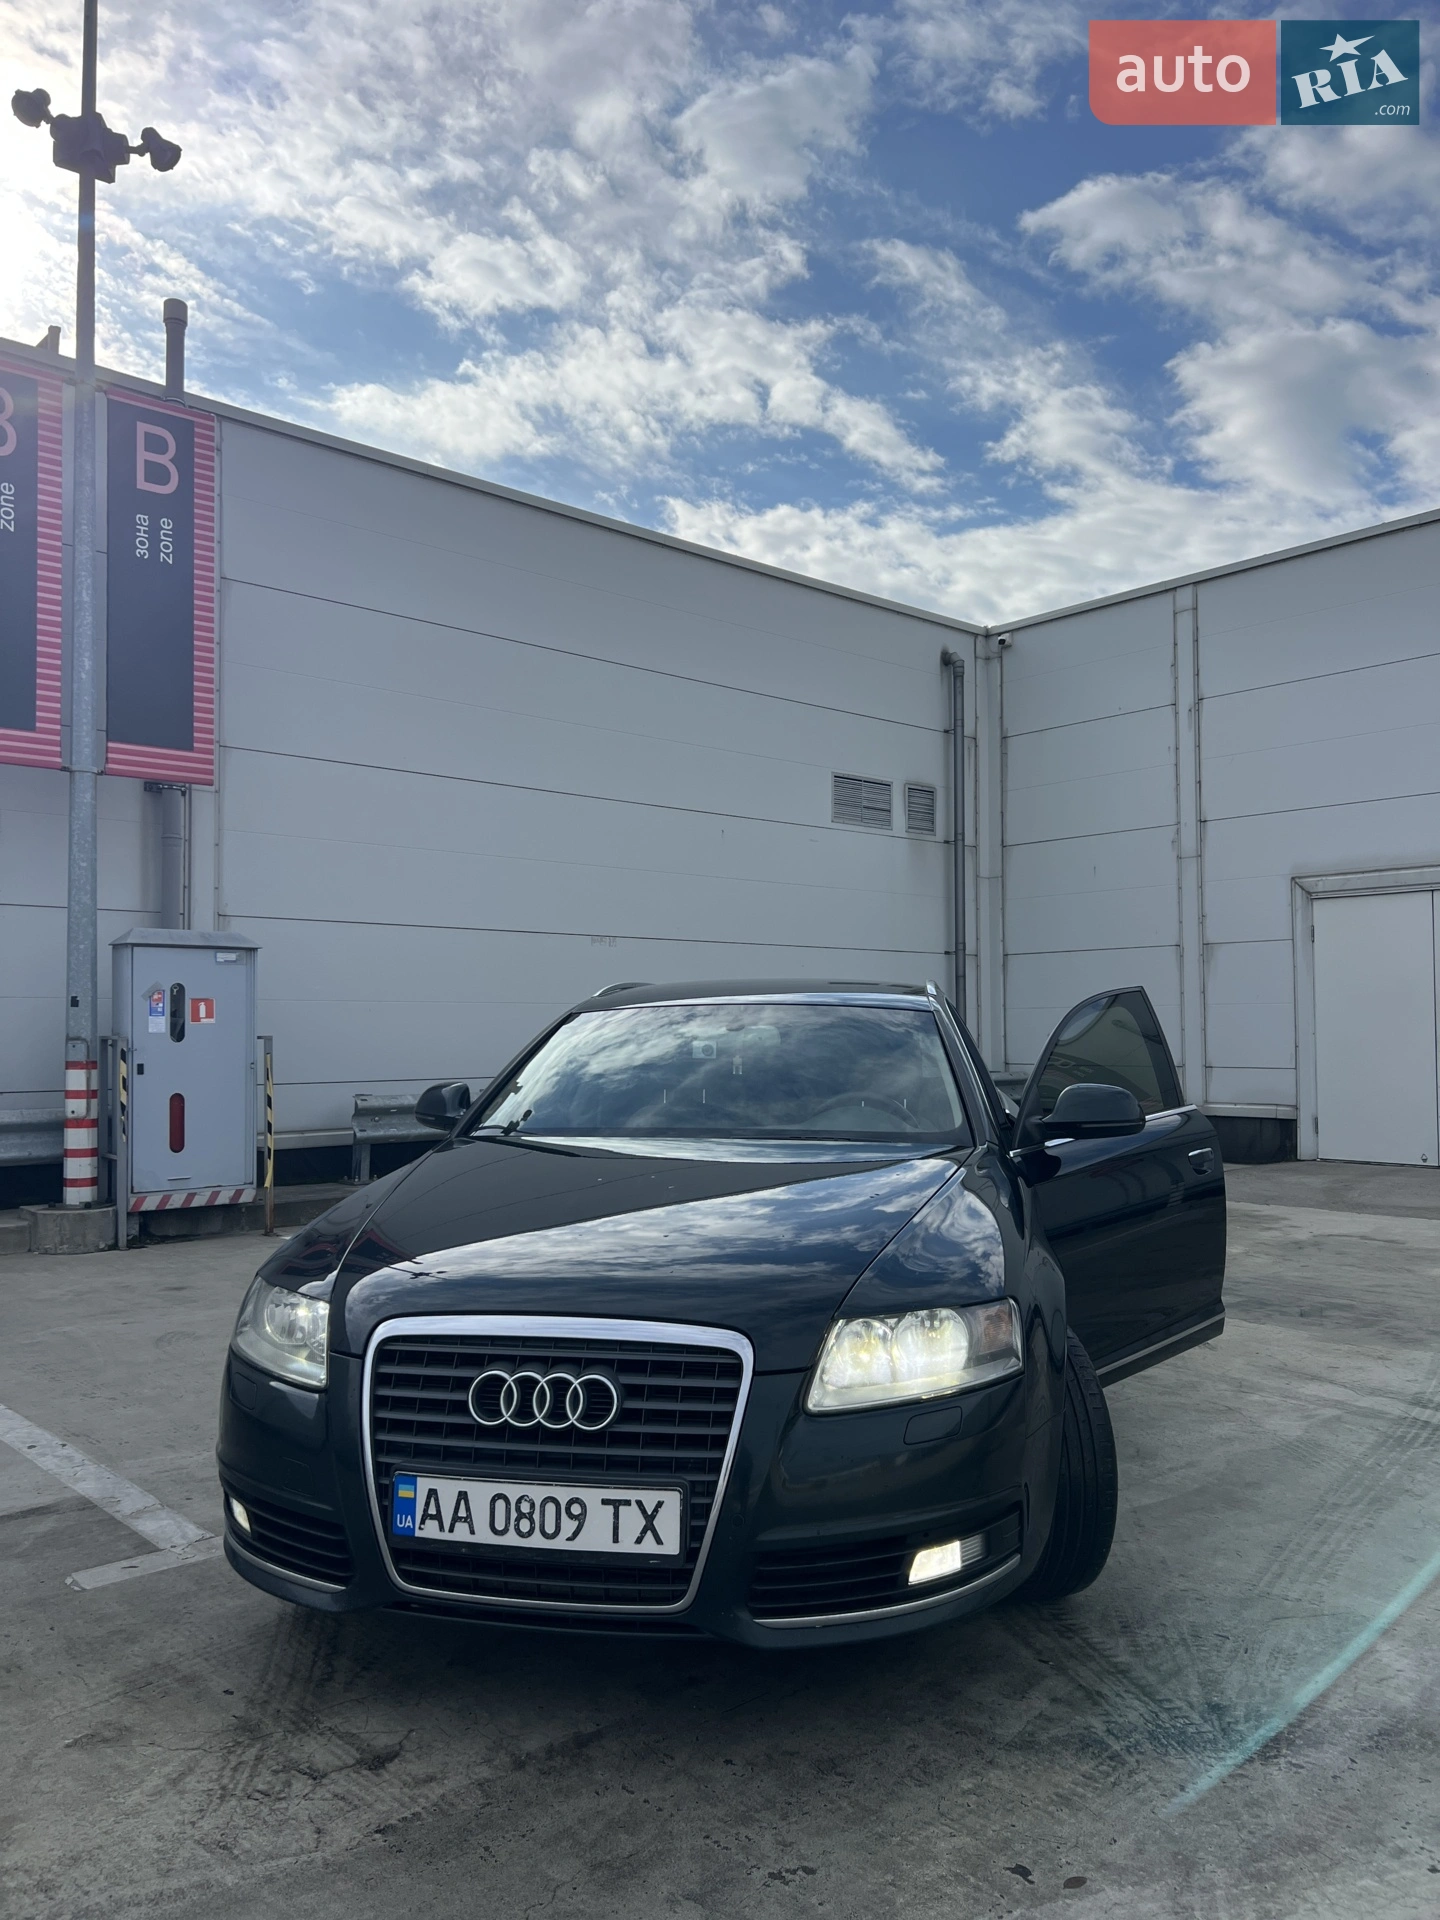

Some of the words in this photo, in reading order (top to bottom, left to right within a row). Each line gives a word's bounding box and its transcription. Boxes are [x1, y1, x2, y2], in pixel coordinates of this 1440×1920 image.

[136, 421, 179, 494] B
[0, 482, 14, 532] zone
[136, 513, 149, 559] зона
[160, 518, 173, 564] zone
[397, 1514, 413, 1528] UA
[418, 1488, 476, 1535] AA
[489, 1492, 588, 1541] 0809
[601, 1498, 664, 1545] TX
